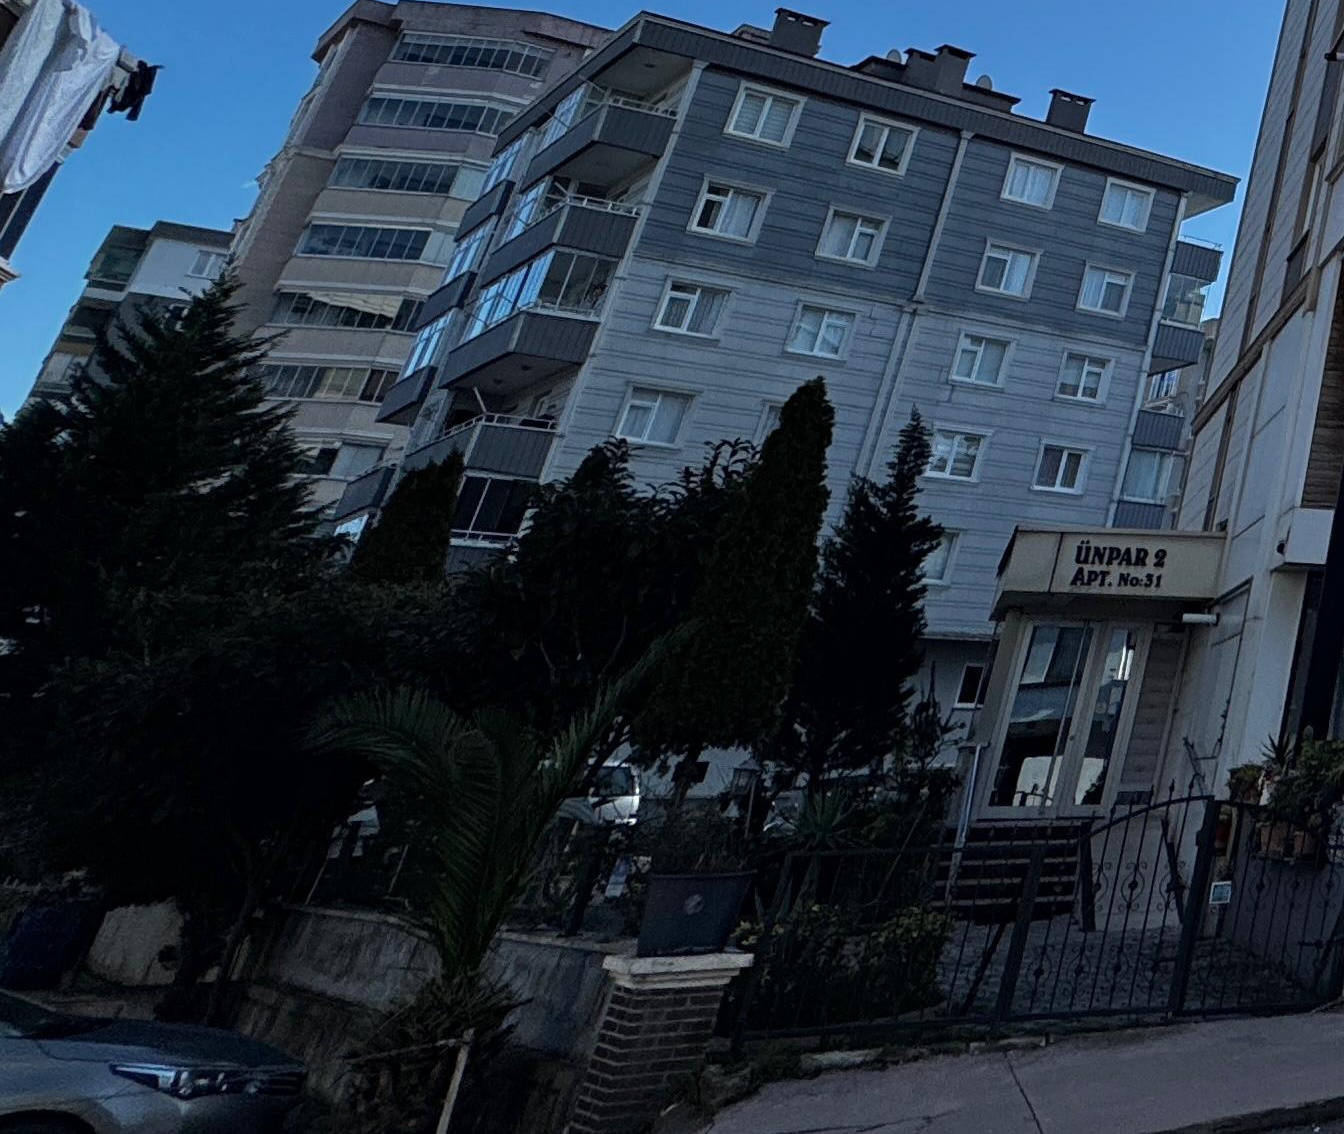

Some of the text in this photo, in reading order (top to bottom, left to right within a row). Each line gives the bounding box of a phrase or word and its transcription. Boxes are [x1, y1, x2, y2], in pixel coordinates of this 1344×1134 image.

[1075, 540, 1167, 568] ÜNPAR 2
[1070, 567, 1162, 588] APT. No:31
